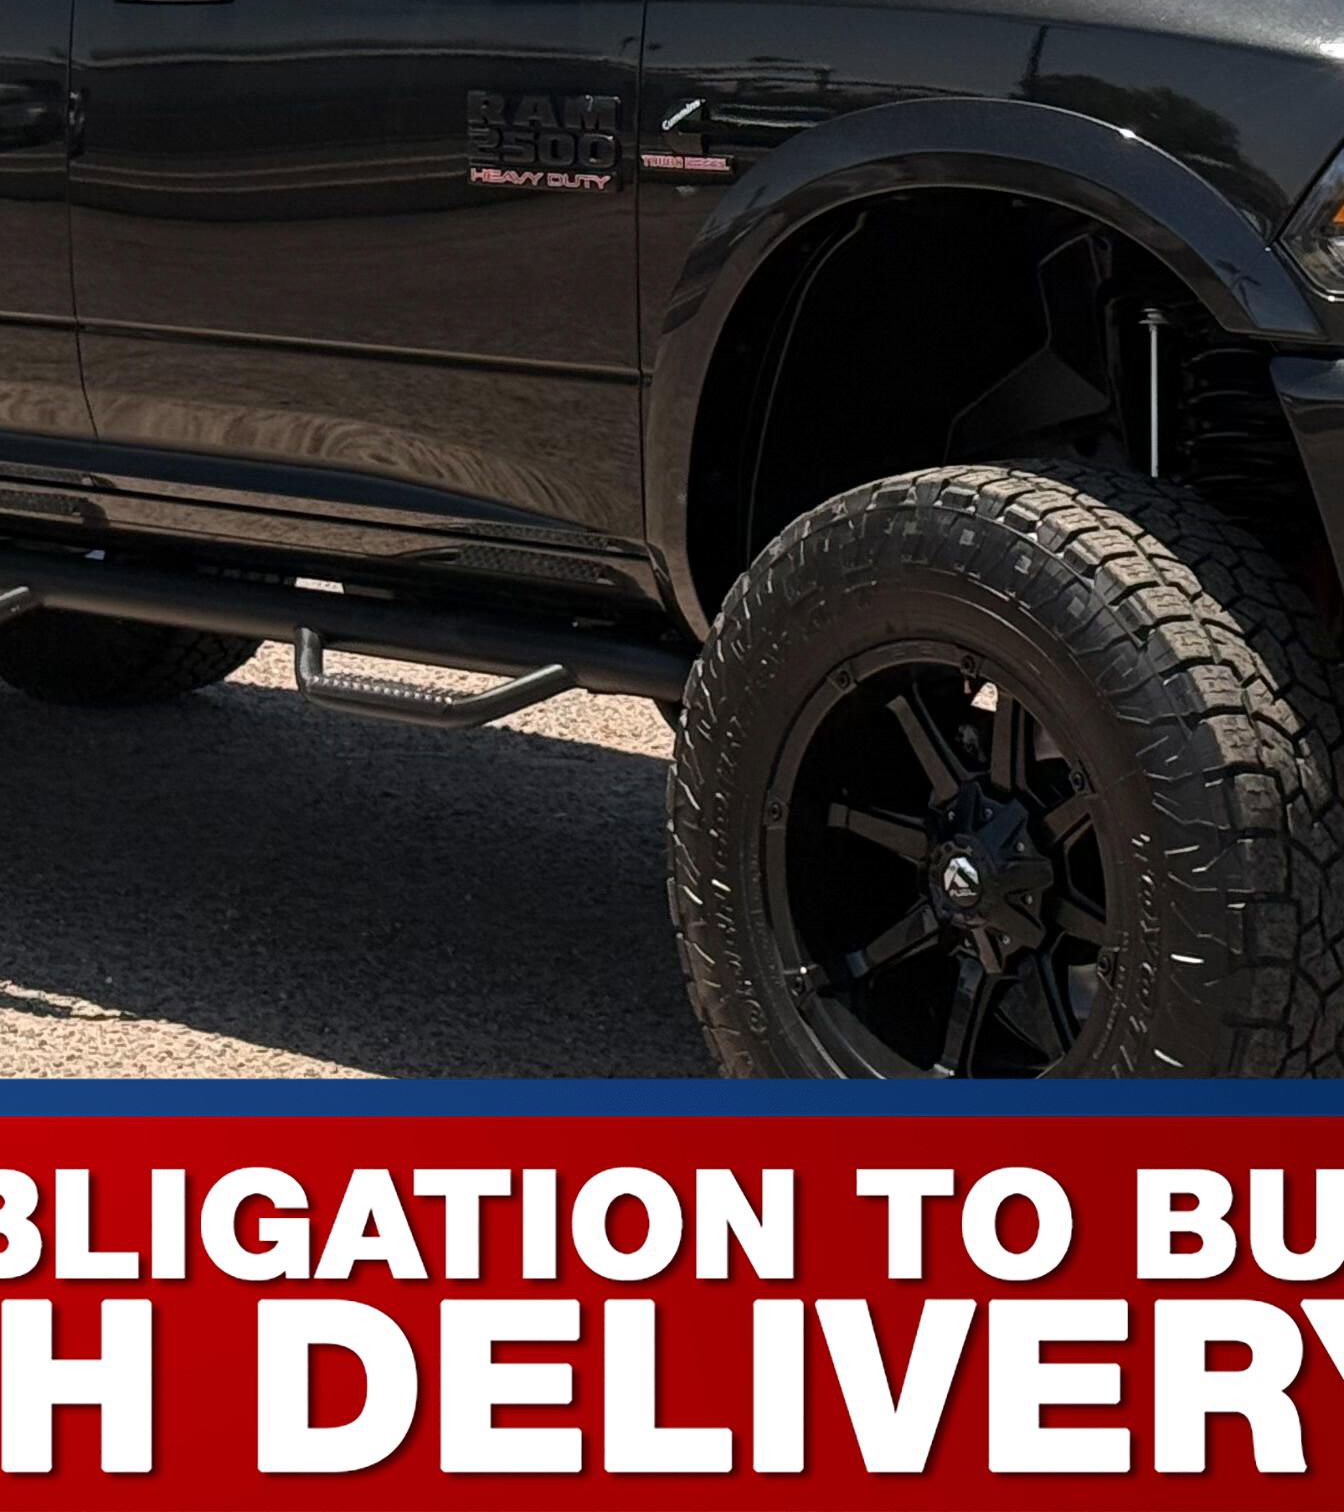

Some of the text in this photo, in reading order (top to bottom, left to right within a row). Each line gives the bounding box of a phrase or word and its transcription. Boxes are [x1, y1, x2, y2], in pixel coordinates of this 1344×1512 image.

[467, 90, 622, 133] RAM
[467, 127, 623, 170] 2500
[470, 167, 612, 190] HEAVY DUTY
